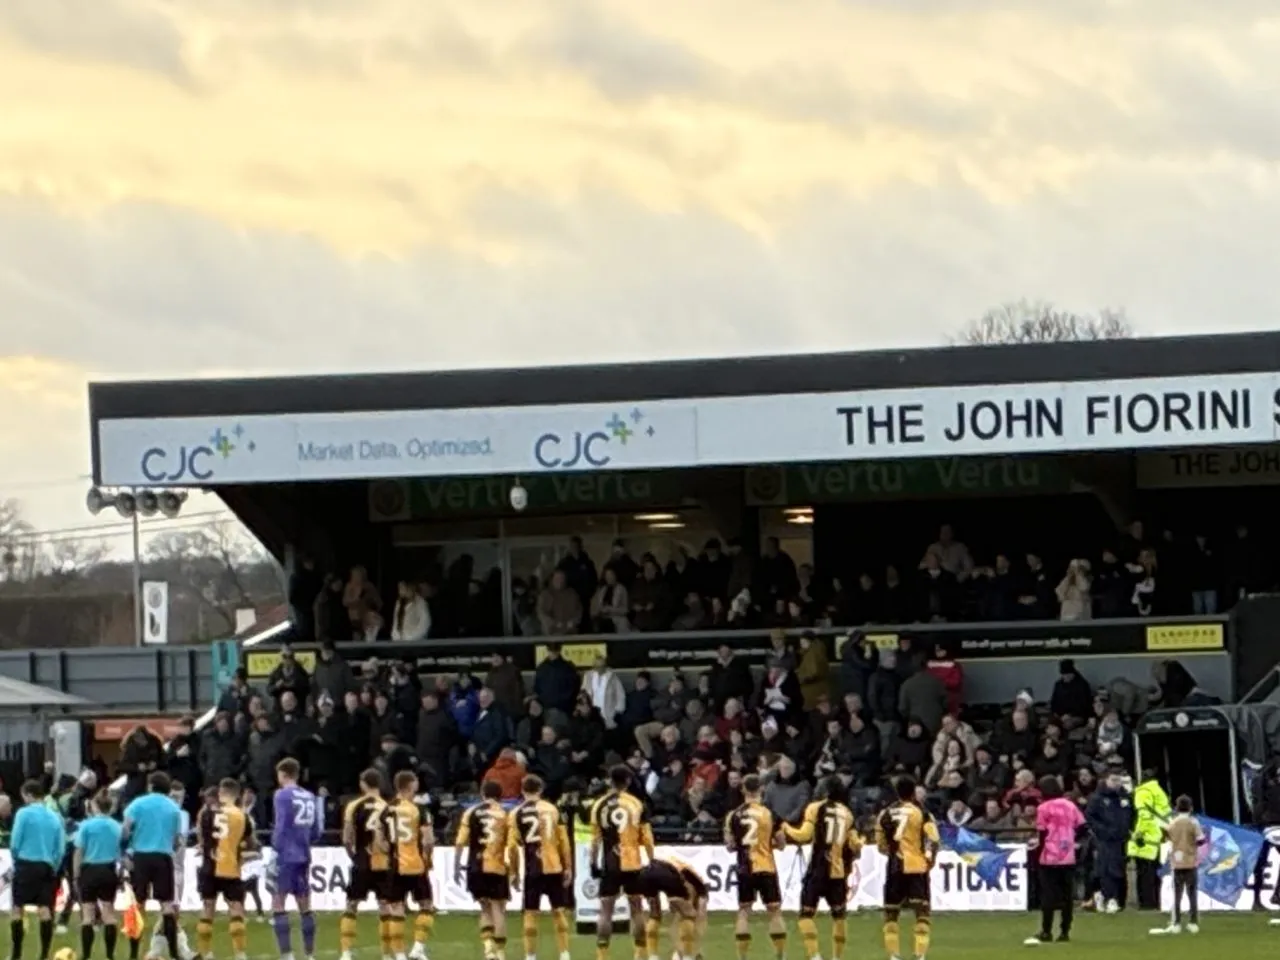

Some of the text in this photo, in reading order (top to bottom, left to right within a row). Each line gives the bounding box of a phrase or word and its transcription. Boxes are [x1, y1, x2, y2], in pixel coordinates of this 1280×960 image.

[836, 404, 925, 446] THE
[944, 397, 1063, 443] JOHN
[1086, 388, 1251, 435] FIORINI
[297, 441, 354, 461] Market
[534, 431, 612, 468] CJC
[1170, 452, 1220, 475] THE
[141, 446, 215, 482] CJC
[212, 813, 229, 840] 5
[385, 816, 412, 844] 15
[478, 817, 497, 844] 3
[521, 813, 553, 843] 21
[740, 817, 758, 846] 2
[823, 816, 846, 845] 11
[891, 814, 909, 841] 7
